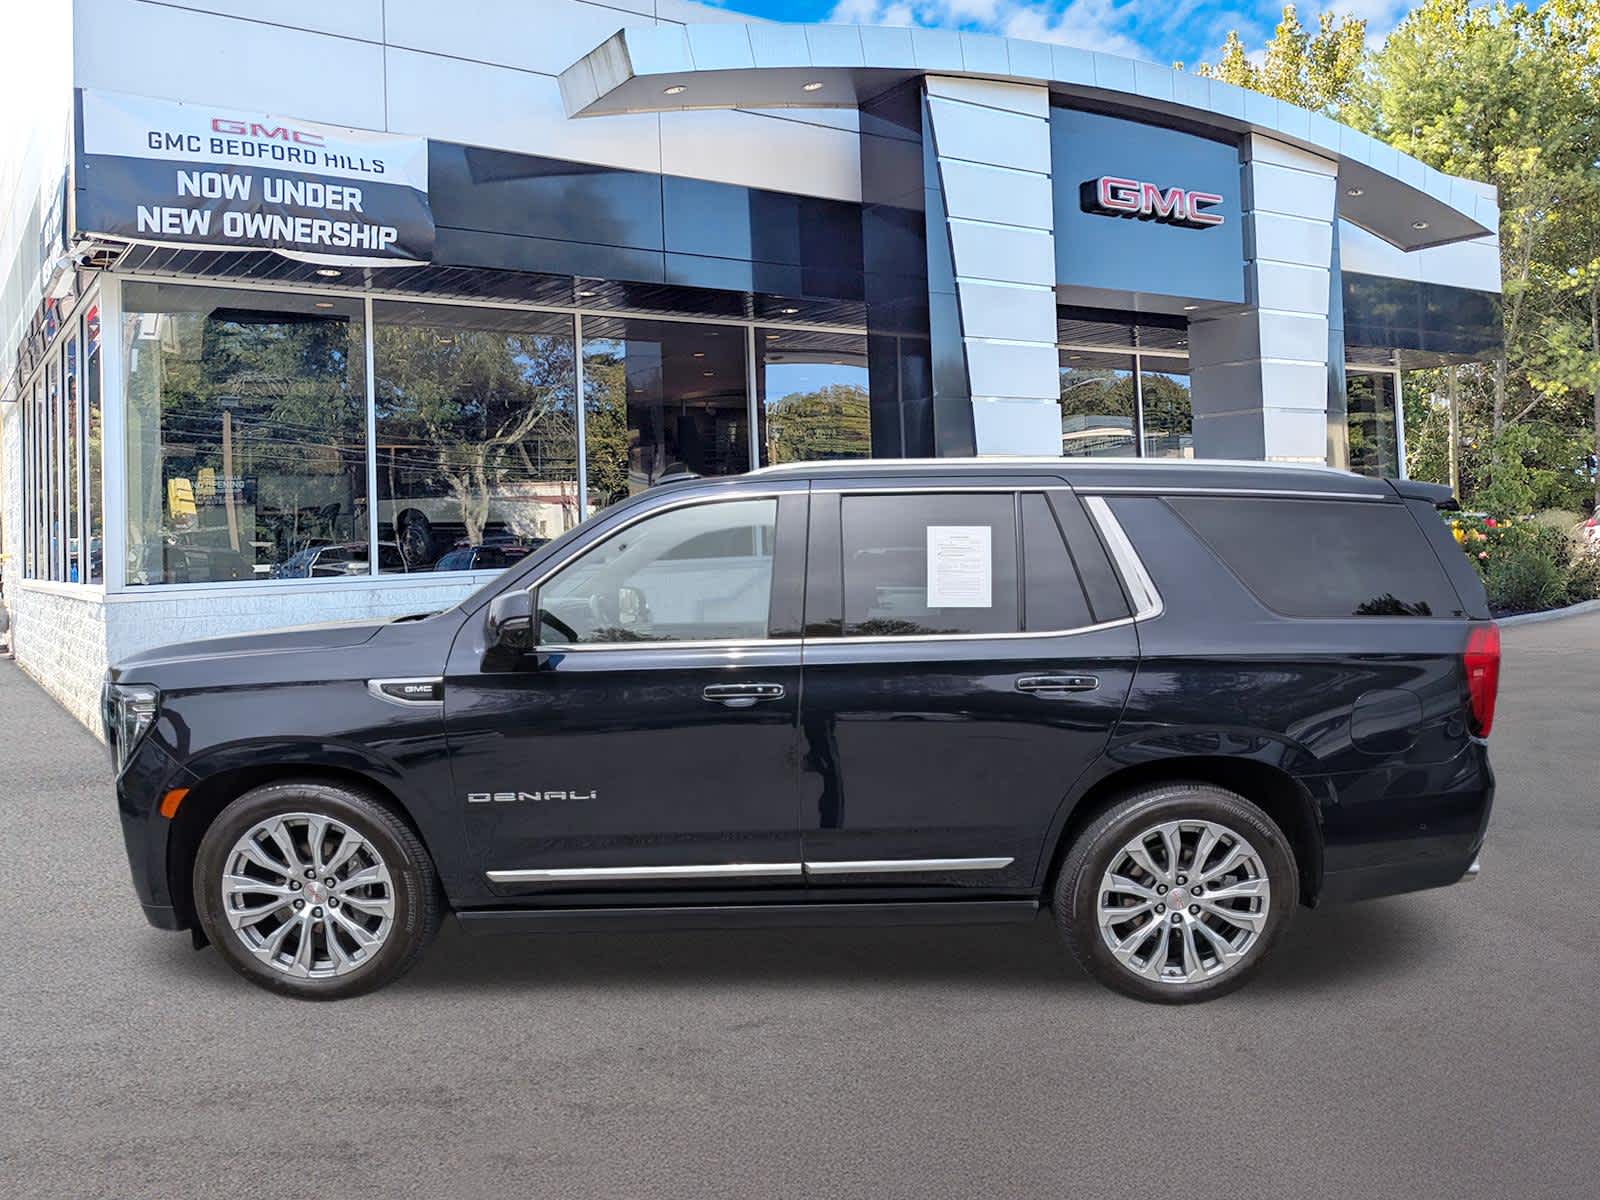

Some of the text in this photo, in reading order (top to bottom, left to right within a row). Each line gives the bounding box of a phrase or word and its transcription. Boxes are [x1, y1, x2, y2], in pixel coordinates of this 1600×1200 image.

[148, 131, 385, 174] GMC BEDFORD HILLS
[211, 118, 326, 148] GMC
[177, 170, 364, 213] NOW UNDER
[1096, 175, 1225, 225] GMC
[136, 205, 398, 250] NEW OWNERSHIP
[404, 685, 433, 693] GMC
[467, 790, 597, 803] DENALI
